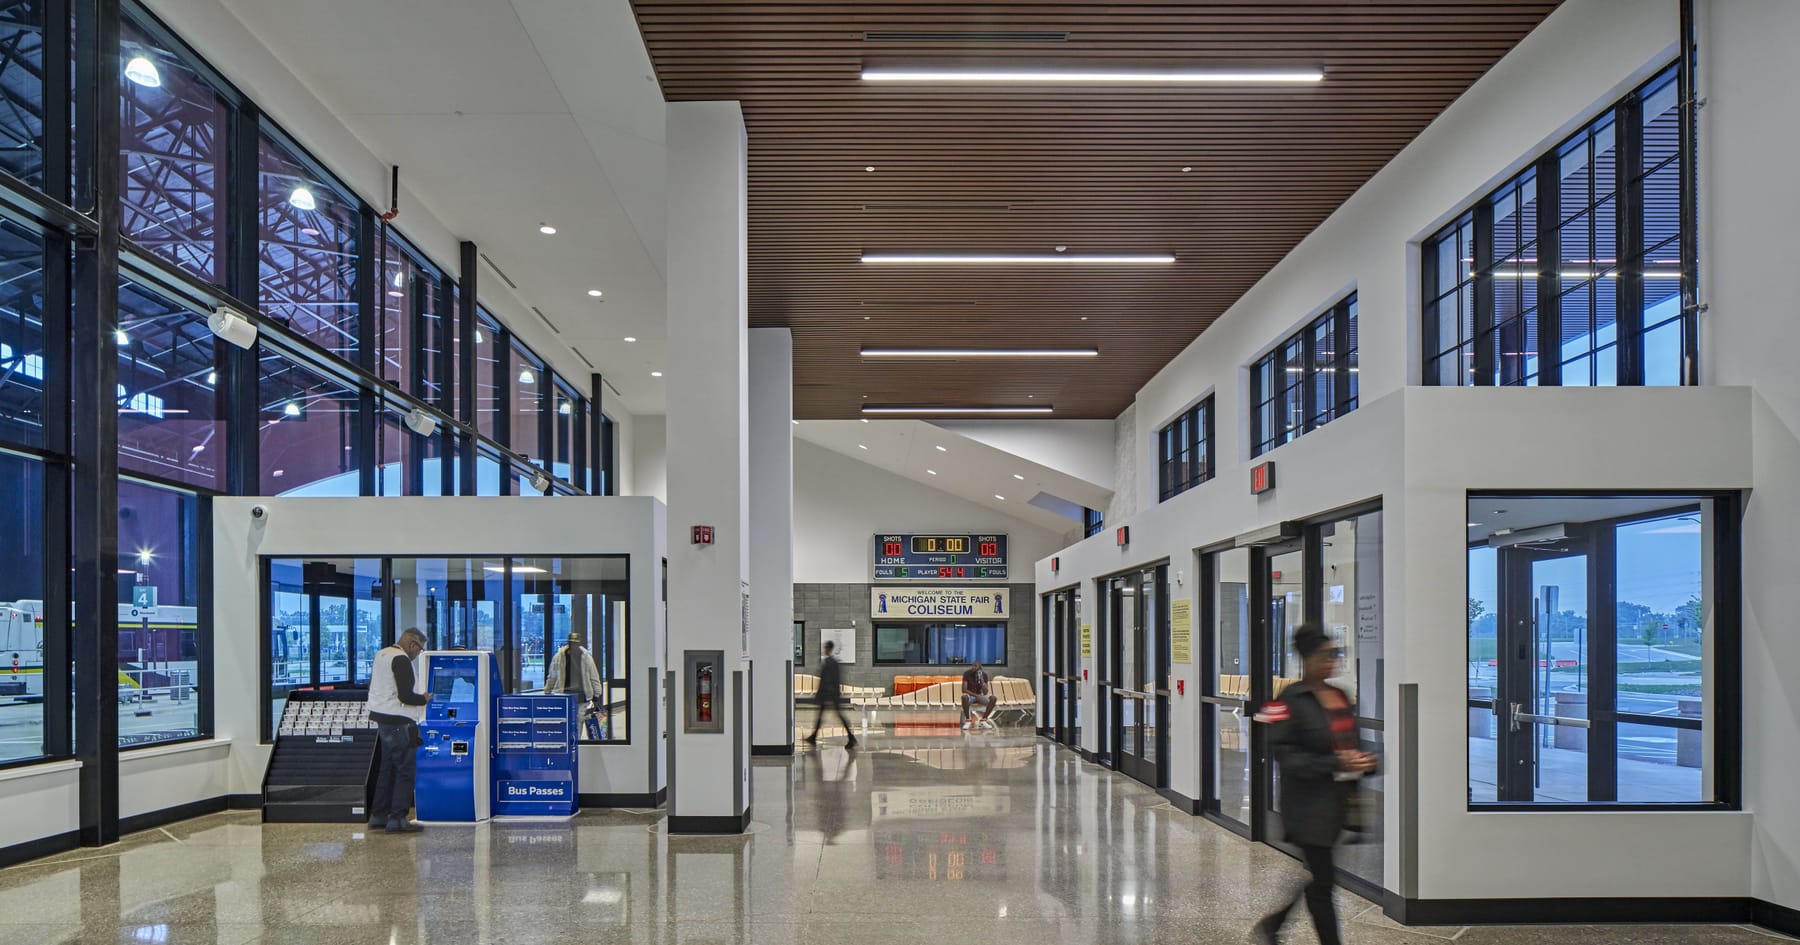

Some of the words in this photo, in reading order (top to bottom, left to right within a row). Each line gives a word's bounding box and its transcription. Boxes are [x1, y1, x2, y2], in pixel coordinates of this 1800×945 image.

[885, 543, 901, 556] 00
[138, 593, 148, 605] 4
[907, 605, 973, 615] COLISEUM
[508, 786, 527, 795] Bus
[529, 786, 564, 795] Passes
